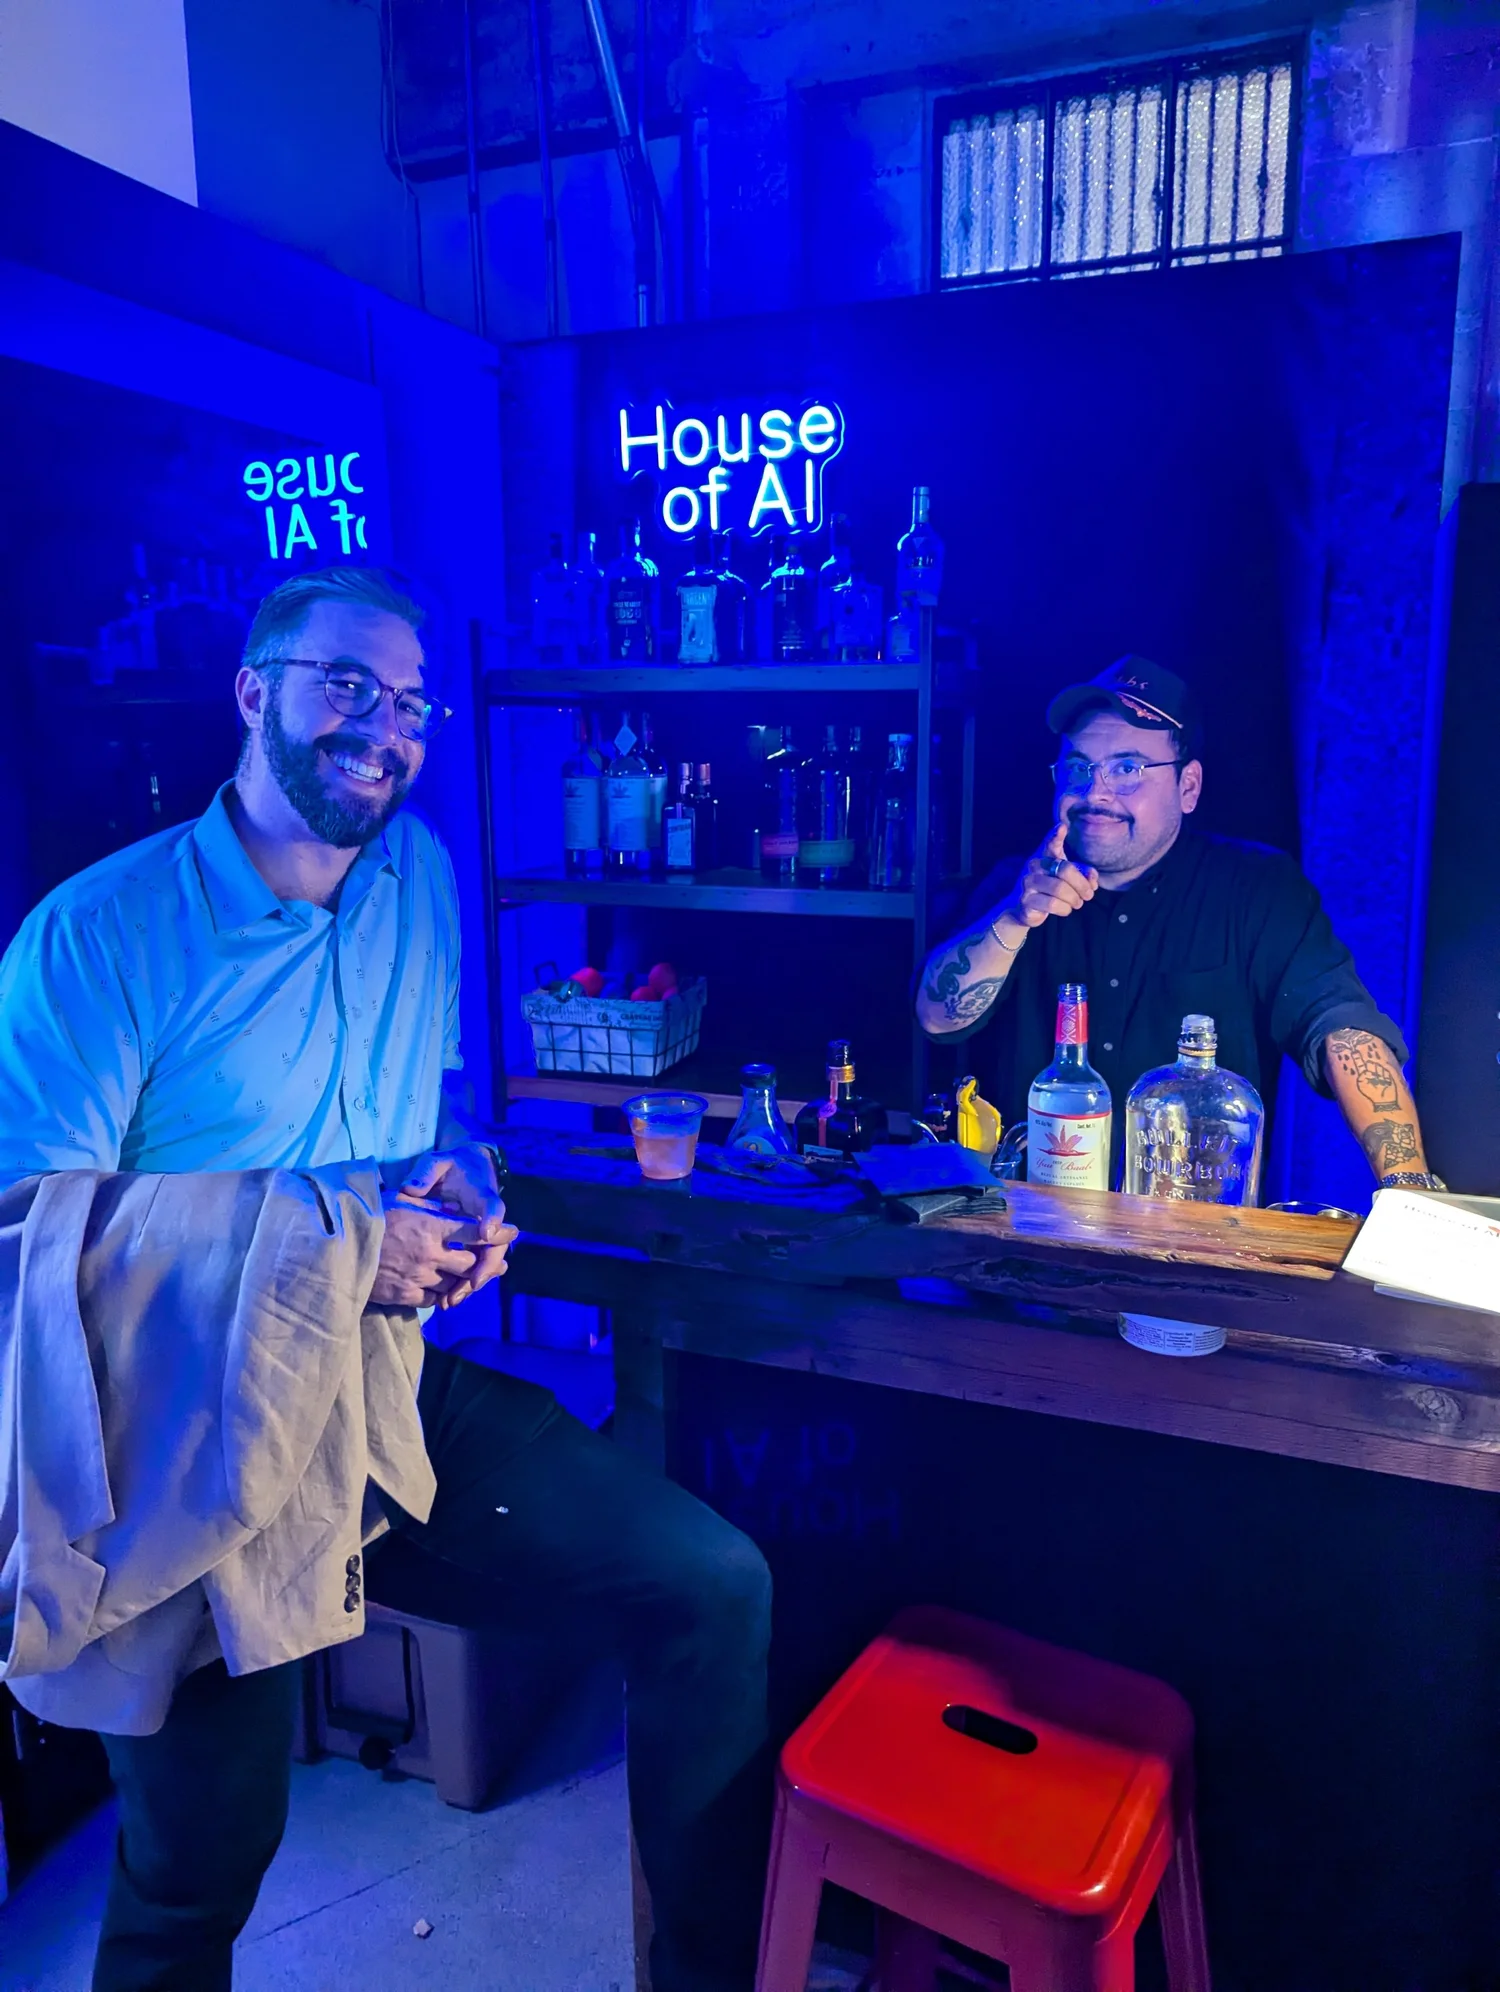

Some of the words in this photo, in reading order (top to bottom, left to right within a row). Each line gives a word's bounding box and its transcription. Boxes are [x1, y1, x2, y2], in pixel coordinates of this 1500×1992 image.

[619, 403, 836, 472] House
[662, 464, 730, 533] of
[752, 458, 814, 529] AI
[1134, 1154, 1242, 1181] BOURBON
